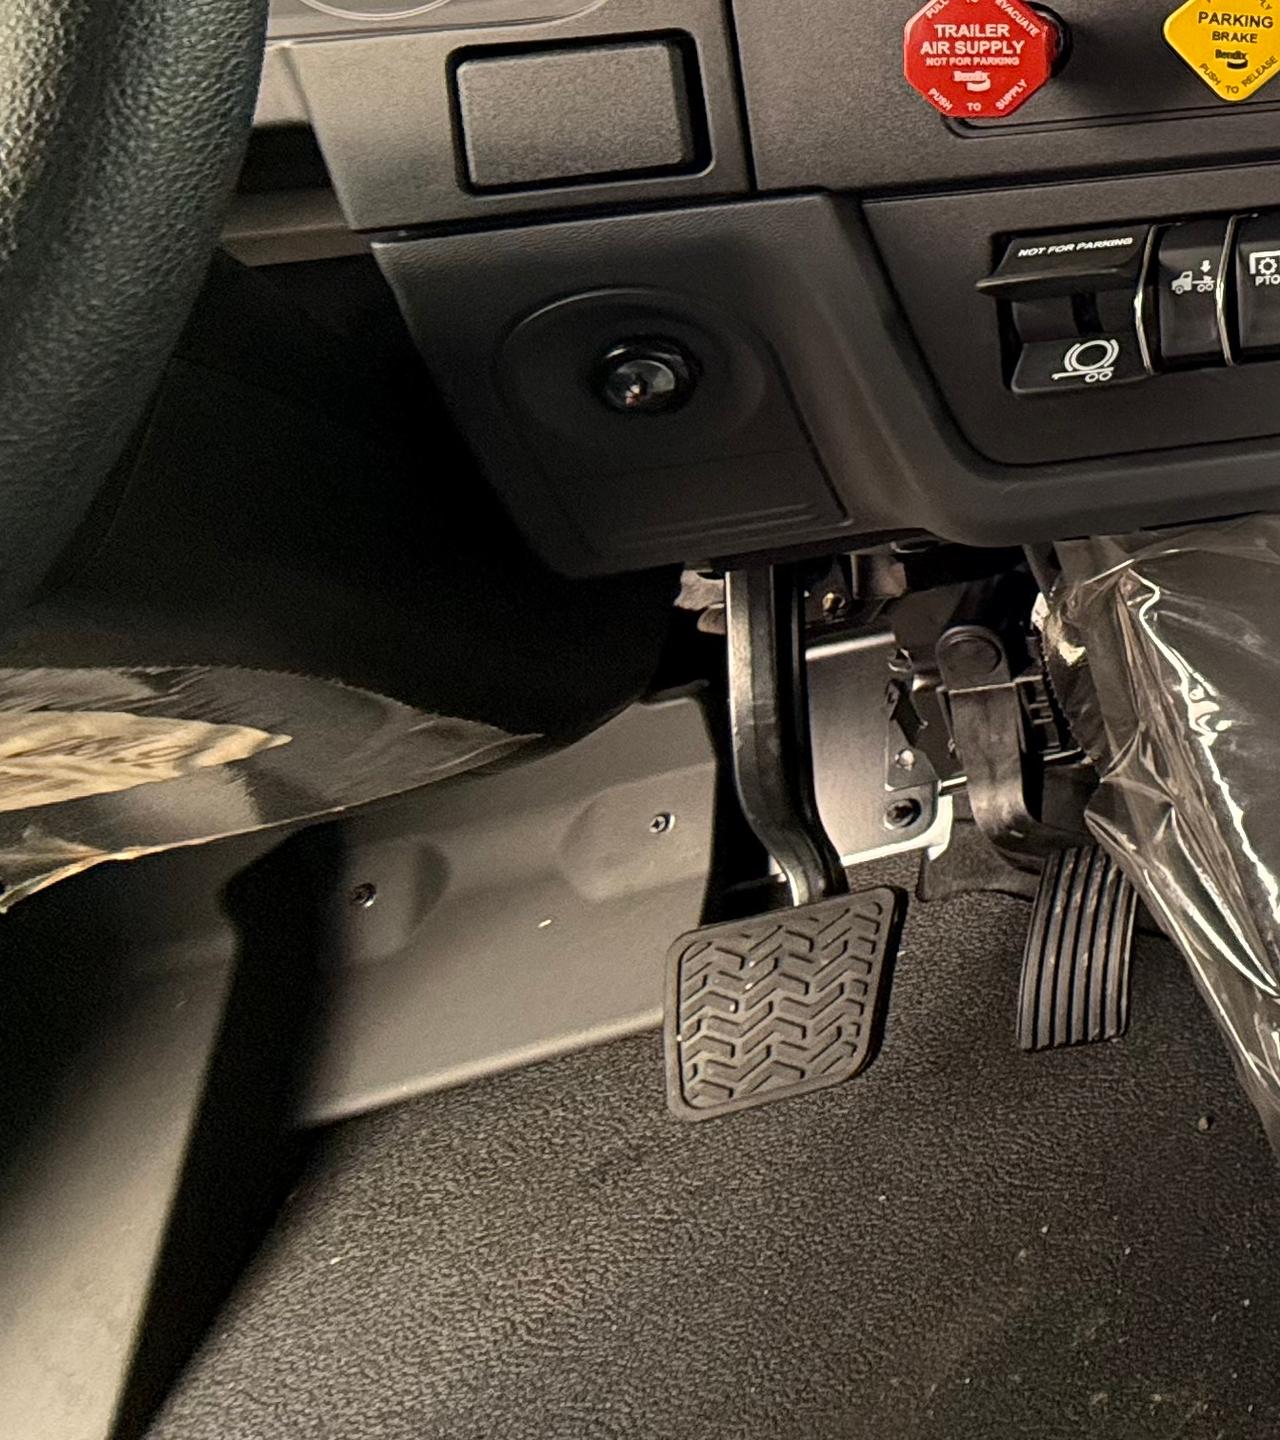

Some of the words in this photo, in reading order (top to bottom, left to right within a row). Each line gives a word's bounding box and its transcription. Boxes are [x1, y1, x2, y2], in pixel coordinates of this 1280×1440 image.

[1198, 12, 1273, 28] PARKING
[934, 24, 1010, 37] TRAILER
[1212, 31, 1258, 43] BRAKE
[920, 41, 950, 55] AIR
[955, 40, 1024, 54] SUPPLY
[1215, 49, 1247, 60] Bendix
[926, 57, 947, 66] NOT
[950, 57, 970, 66] FOR
[974, 57, 1019, 66] PARKING
[1199, 63, 1221, 85] PUSH
[1241, 56, 1278, 87] RELEASE
[928, 88, 953, 111] PUSH
[967, 103, 981, 111] TO
[995, 80, 1028, 110] SUPPLY
[1017, 246, 1046, 258] NOT
[1047, 242, 1075, 255] FOR
[1076, 236, 1133, 251] PARKING
